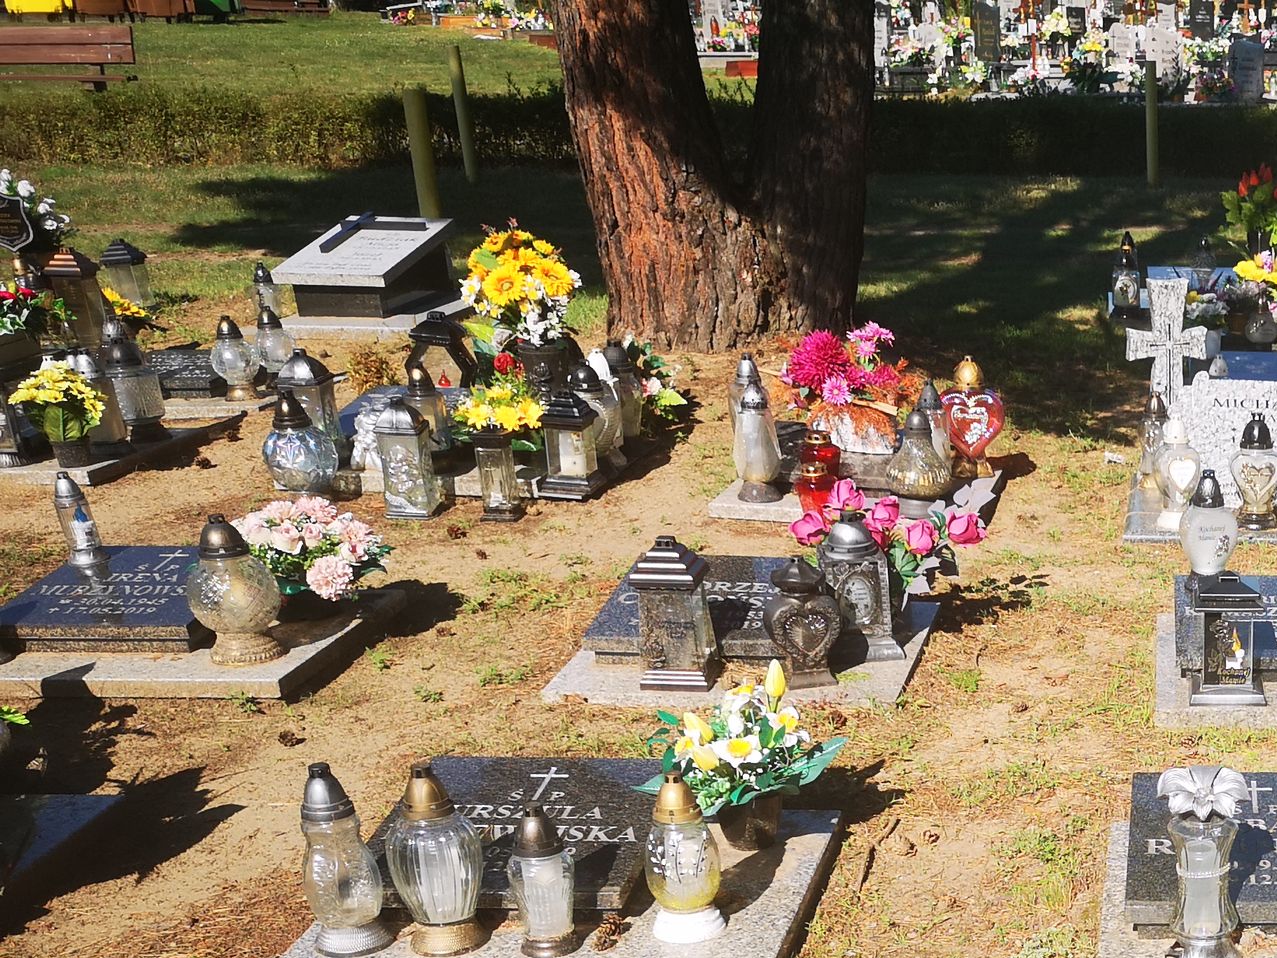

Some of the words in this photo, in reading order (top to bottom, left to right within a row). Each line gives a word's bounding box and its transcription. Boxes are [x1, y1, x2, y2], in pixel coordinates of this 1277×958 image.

[102, 572, 180, 583] IRENA
[30, 585, 188, 597] MURZYNOWS
[547, 791, 565, 801] P
